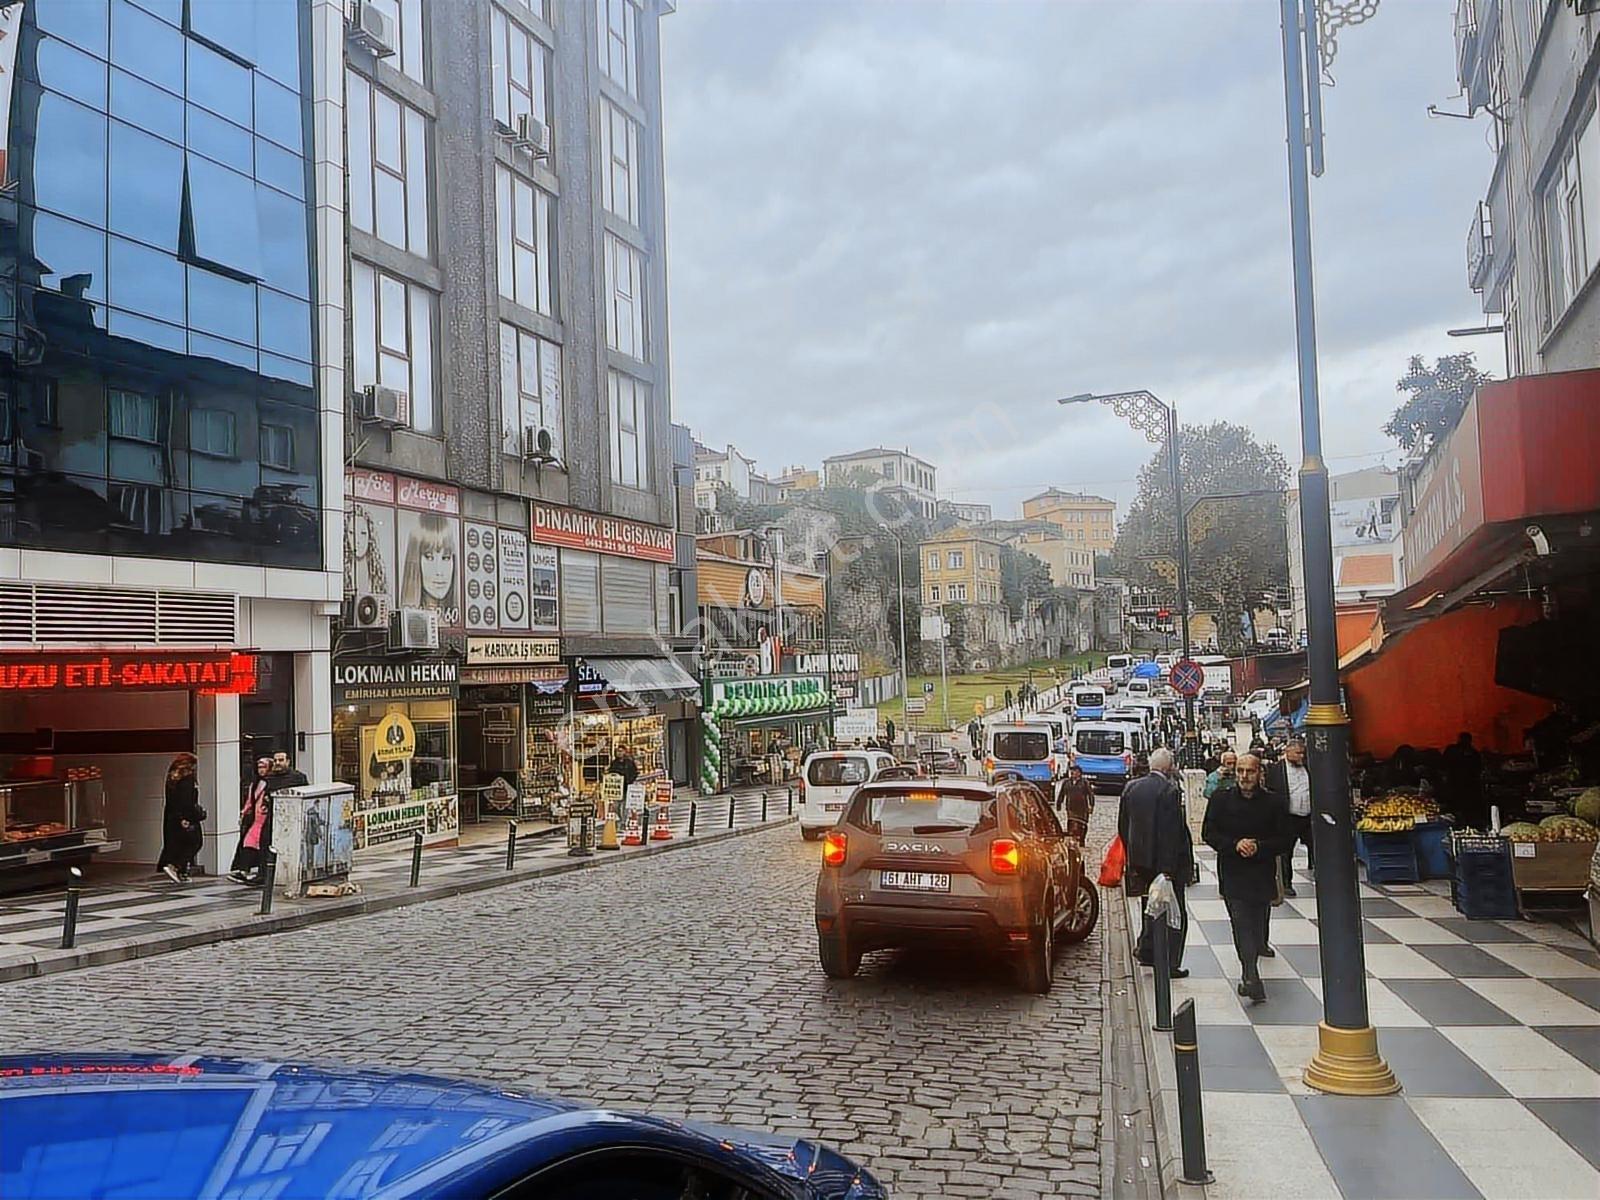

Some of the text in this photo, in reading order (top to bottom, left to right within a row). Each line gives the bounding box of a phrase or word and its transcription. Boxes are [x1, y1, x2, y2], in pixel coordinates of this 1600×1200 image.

[335, 660, 456, 684] LOKMAN HEKİM
[887, 843, 942, 852] DACIA
[888, 872, 947, 887] 61 AHT 128
